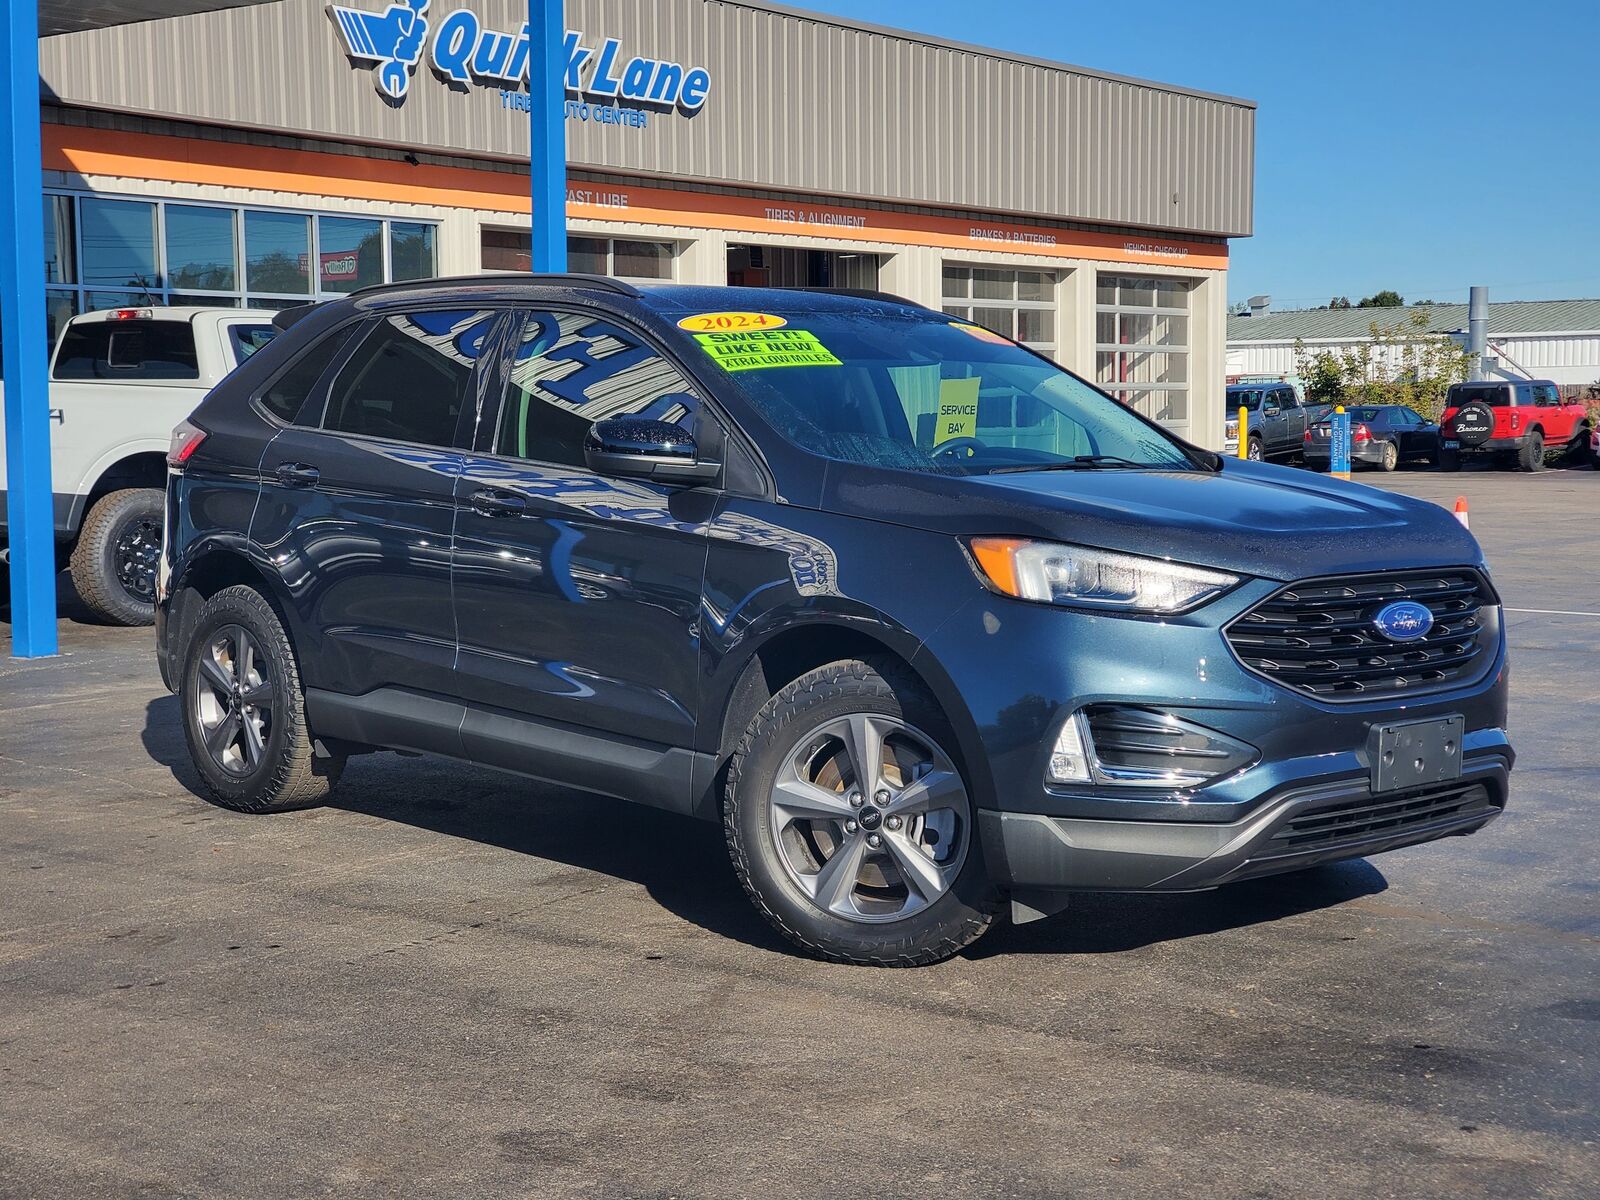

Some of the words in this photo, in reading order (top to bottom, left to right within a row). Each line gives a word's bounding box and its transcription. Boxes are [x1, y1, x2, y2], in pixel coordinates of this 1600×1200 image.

[433, 9, 592, 90] Quik
[589, 38, 711, 108] Lane
[564, 100, 590, 121] UTO
[593, 104, 648, 128] CENTER
[564, 188, 592, 206] AST
[595, 192, 629, 208] LUBE
[765, 208, 795, 223] TIRES
[798, 210, 805, 224] &
[808, 212, 866, 230] ALIGNMENT
[970, 228, 1004, 242] BRAKES
[1006, 231, 1012, 243] &
[1013, 232, 1056, 248] BATTERIES
[1123, 242, 1153, 256] VEHICLE
[699, 315, 768, 330] 2024
[709, 332, 802, 343] SWEET!
[713, 344, 762, 356] LIKE
[767, 342, 812, 352] NEW
[722, 358, 761, 368] XTRA
[764, 356, 791, 364] LOW
[792, 352, 834, 362] MILES
[941, 405, 976, 416] SERVICE
[948, 423, 966, 434] BAY
[1456, 424, 1488, 432] Bronco
[1393, 610, 1423, 631] Ford
